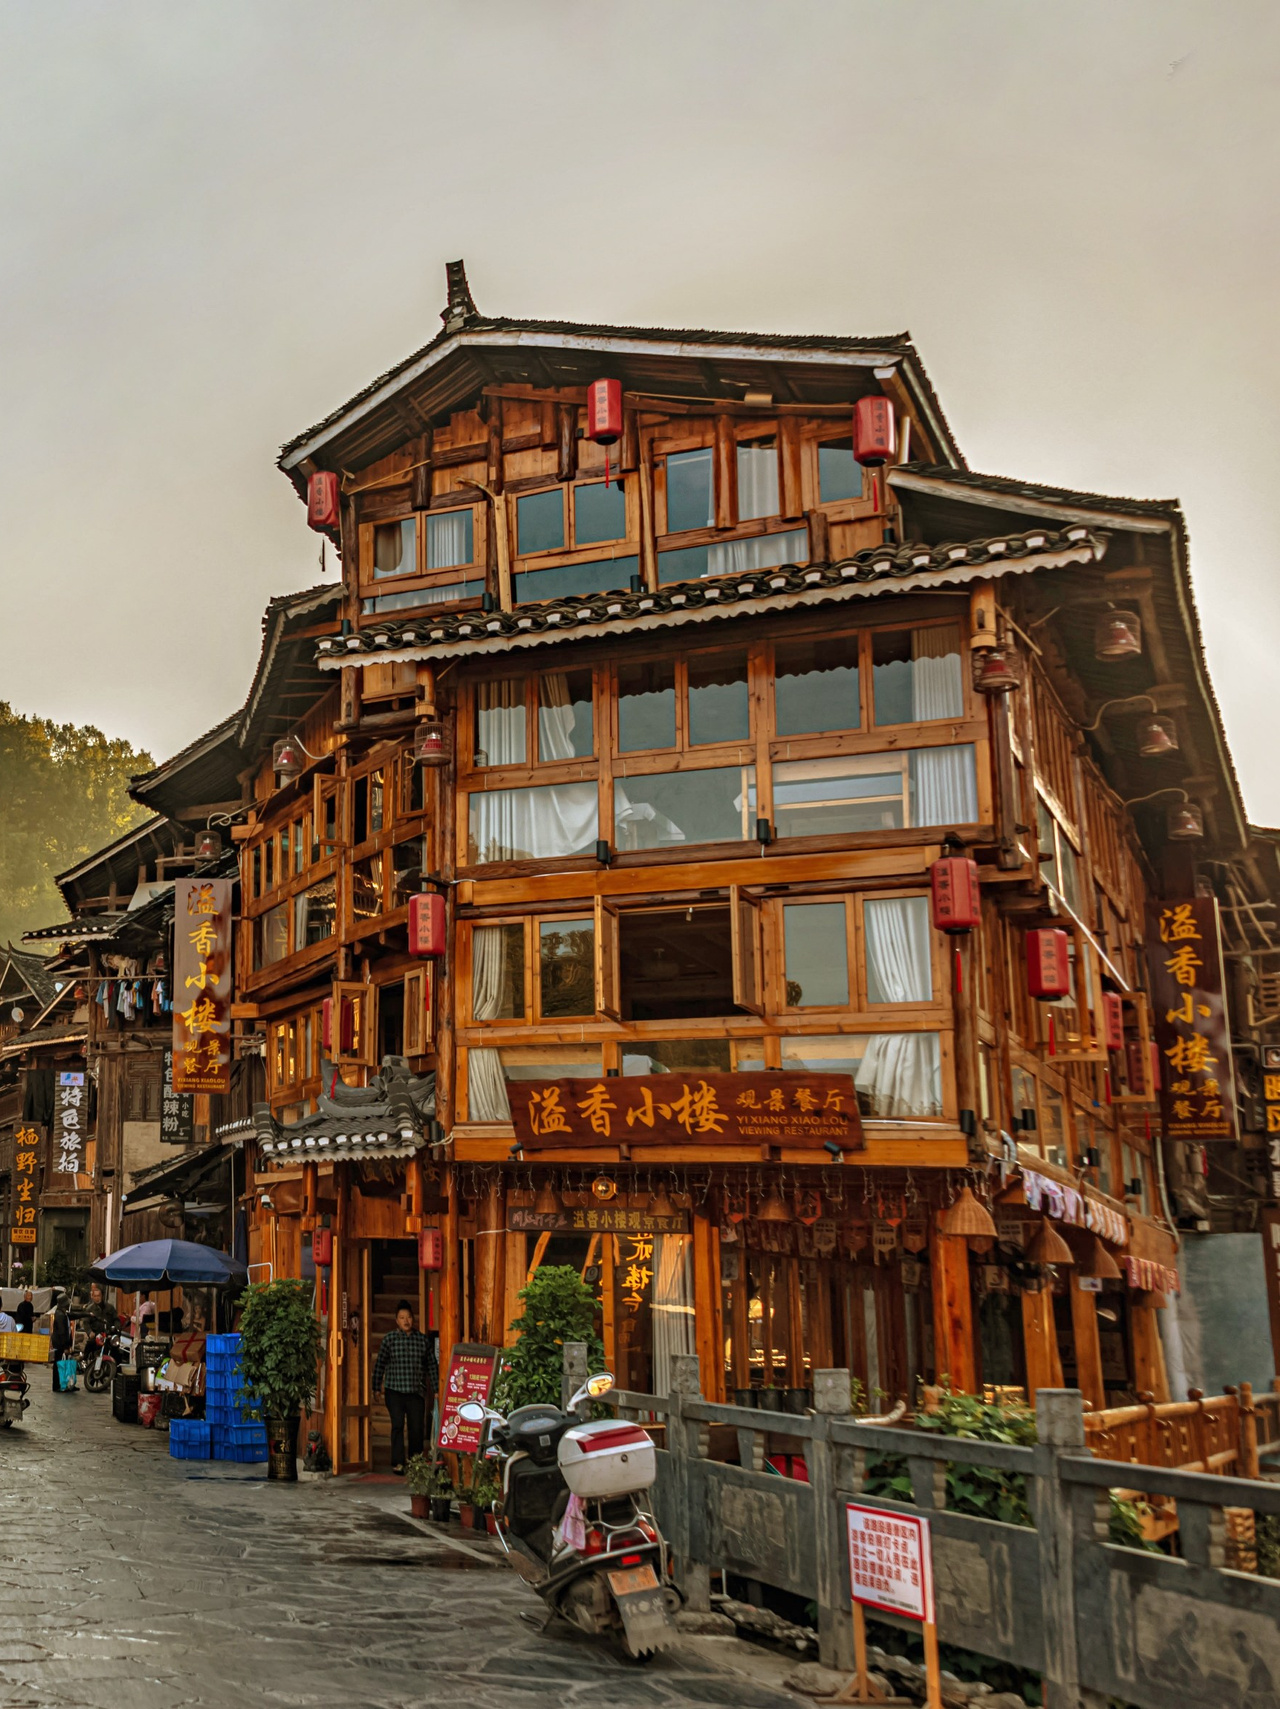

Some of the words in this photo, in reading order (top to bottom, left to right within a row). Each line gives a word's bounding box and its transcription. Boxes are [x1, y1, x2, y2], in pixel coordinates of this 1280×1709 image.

[180, 883, 222, 1034] 溢香小楼
[1159, 903, 1219, 1074] 溢香小楼
[182, 1040, 221, 1056] 观景
[183, 1057, 222, 1075] 餐厅
[528, 1079, 729, 1137] 溢香小楼
[736, 1087, 845, 1112] 观景餐厅
[58, 1086, 83, 1173] 特色旅拍
[736, 1115, 748, 1124] YI
[750, 1115, 788, 1124] XIANG
[790, 1115, 820, 1125] XIAO
[823, 1115, 848, 1125] LOU
[738, 1126, 779, 1135] VIEWING
[784, 1126, 849, 1136] RESTAURANT
